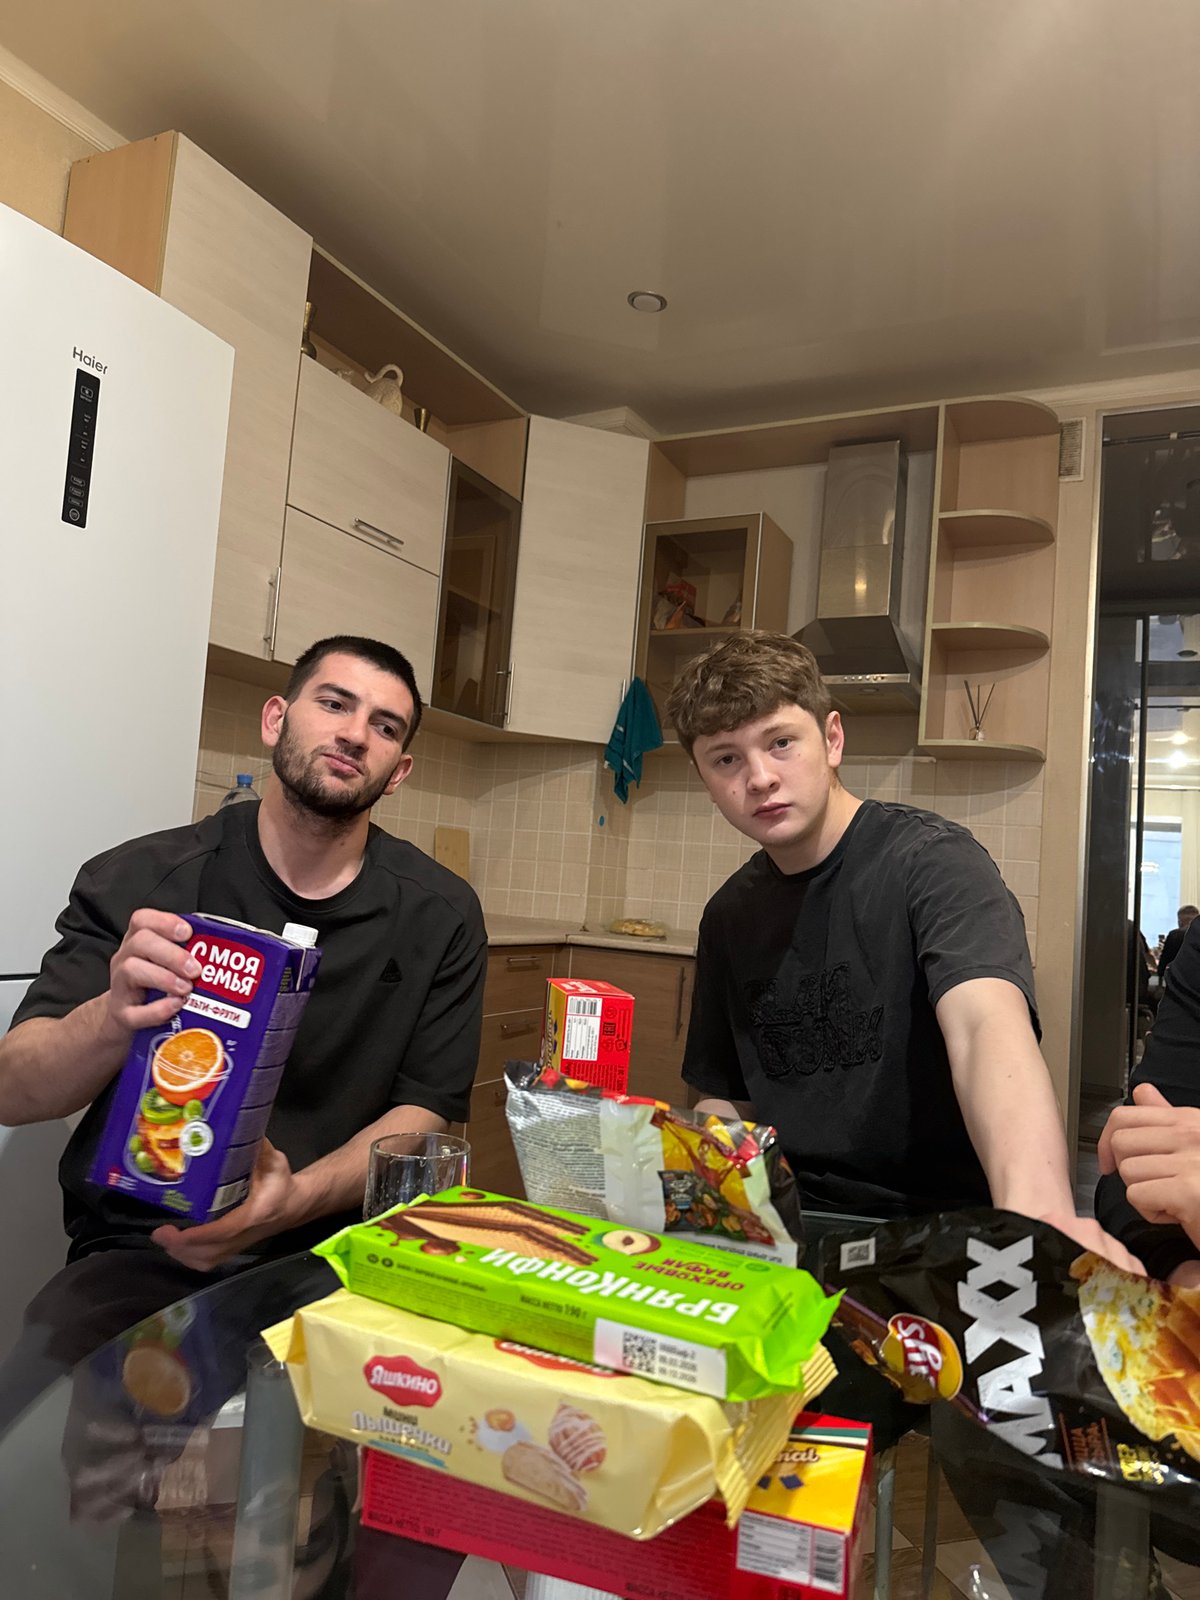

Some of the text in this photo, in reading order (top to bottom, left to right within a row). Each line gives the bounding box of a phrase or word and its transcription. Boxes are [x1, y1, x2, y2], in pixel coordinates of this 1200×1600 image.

[72, 346, 108, 375] Haier
[187, 997, 241, 1022] ЛЬТИ-ФРУТИ
[634, 1261, 745, 1291] ОРЕХОВЫЕ
[662, 1258, 731, 1278] ВАФЛИ
